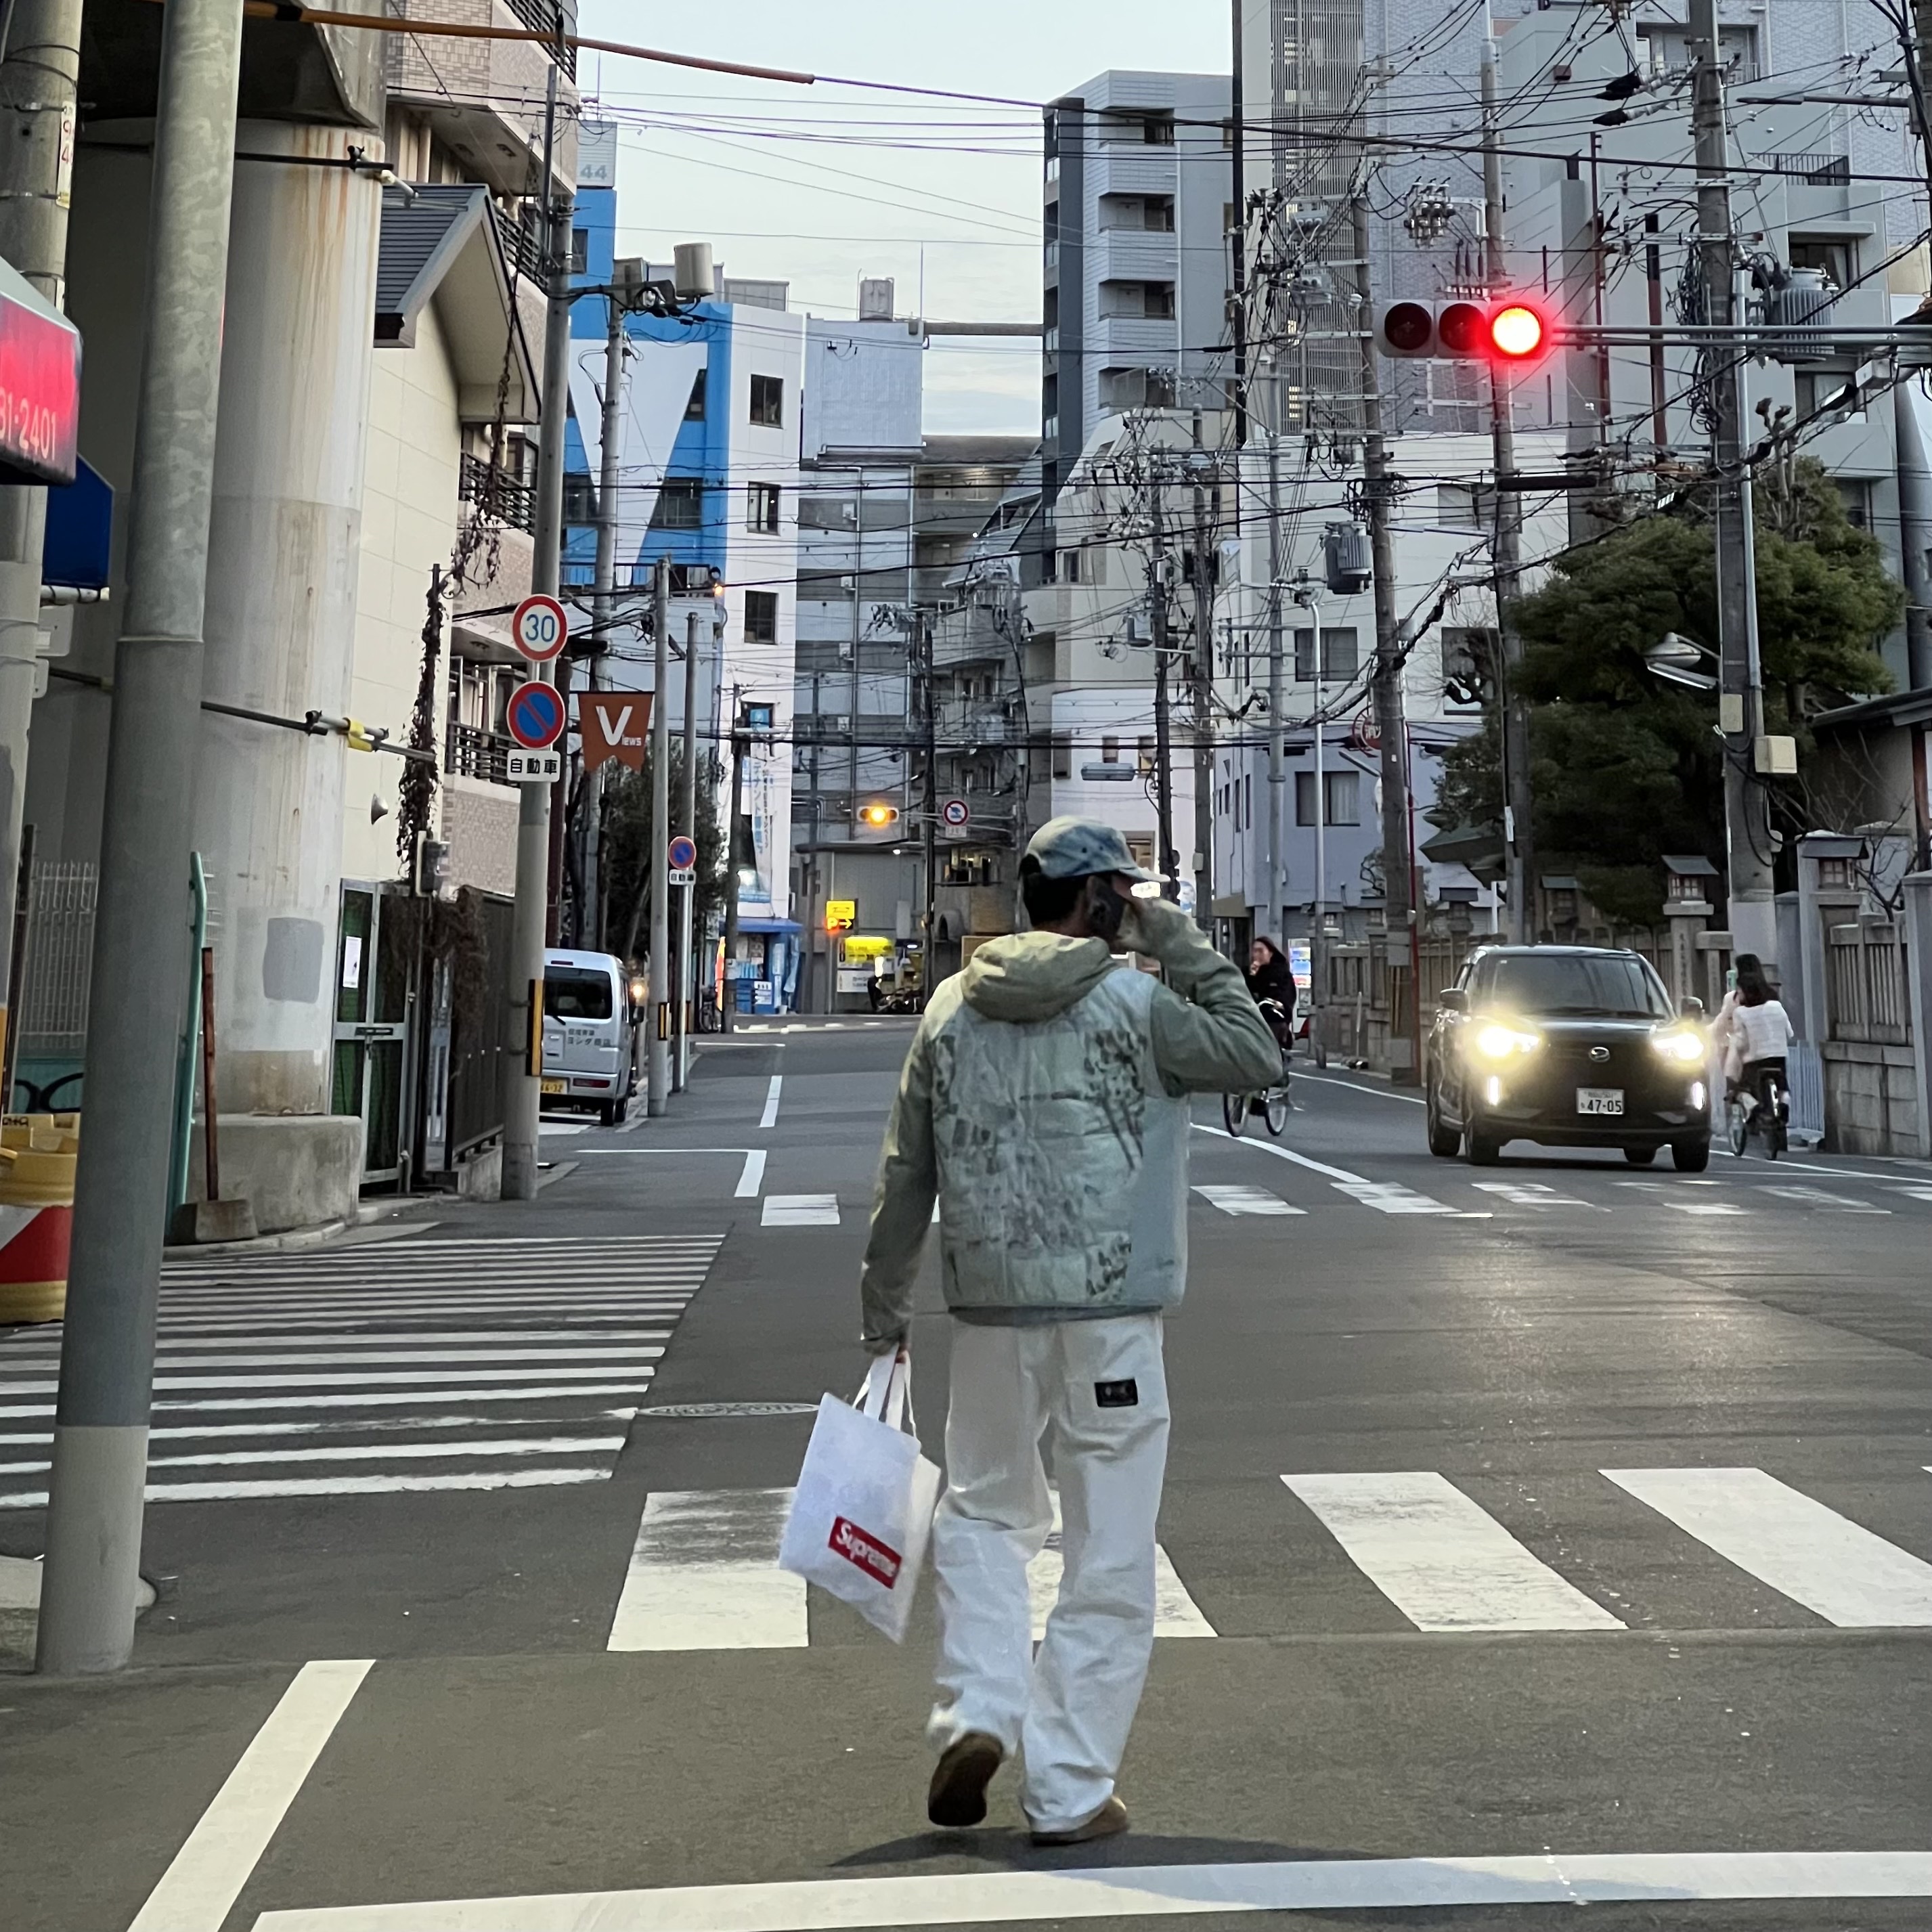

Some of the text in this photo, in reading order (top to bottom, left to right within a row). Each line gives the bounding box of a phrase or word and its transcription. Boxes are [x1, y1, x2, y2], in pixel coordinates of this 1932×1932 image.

[525, 613, 555, 642] 30
[510, 758, 558, 774] 自動車
[1587, 1099, 1622, 1112] 47-05
